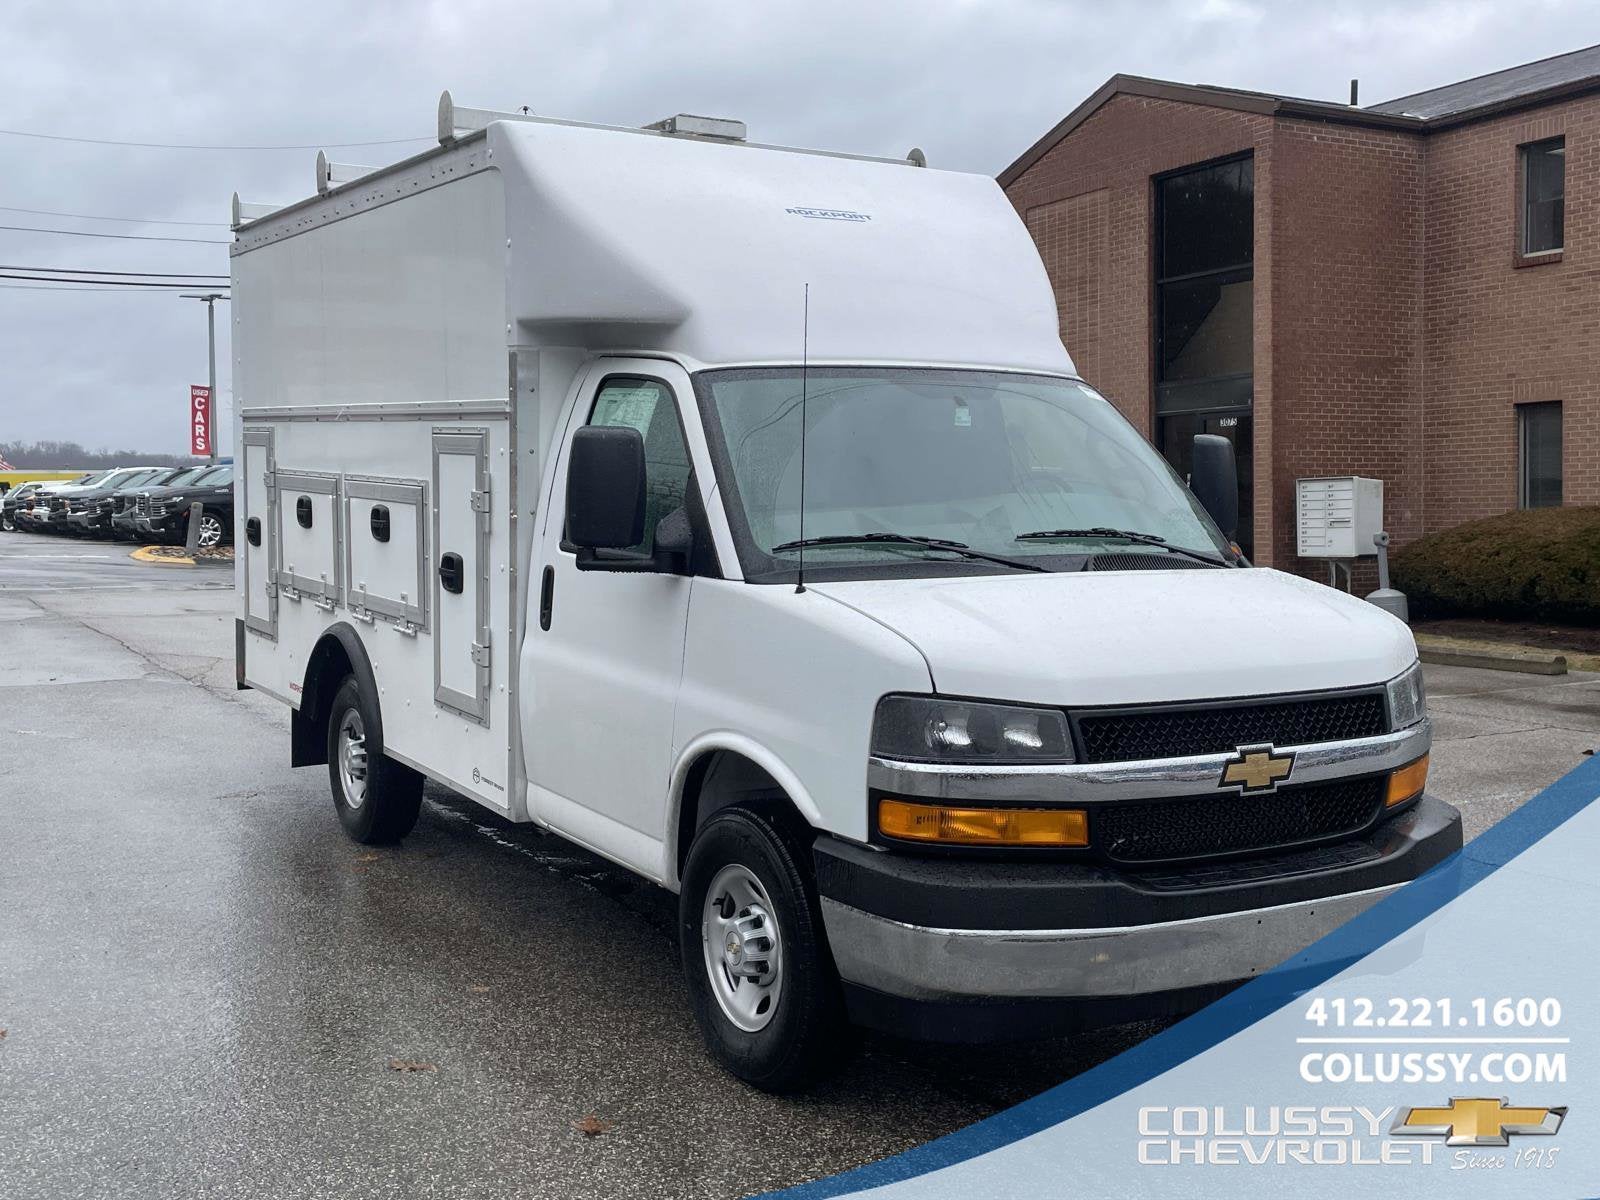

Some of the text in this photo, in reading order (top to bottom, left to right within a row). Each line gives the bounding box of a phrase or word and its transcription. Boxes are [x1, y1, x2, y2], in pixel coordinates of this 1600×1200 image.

[785, 208, 872, 221] ROCKPORT
[192, 389, 209, 397] USED
[194, 397, 206, 450] CARS
